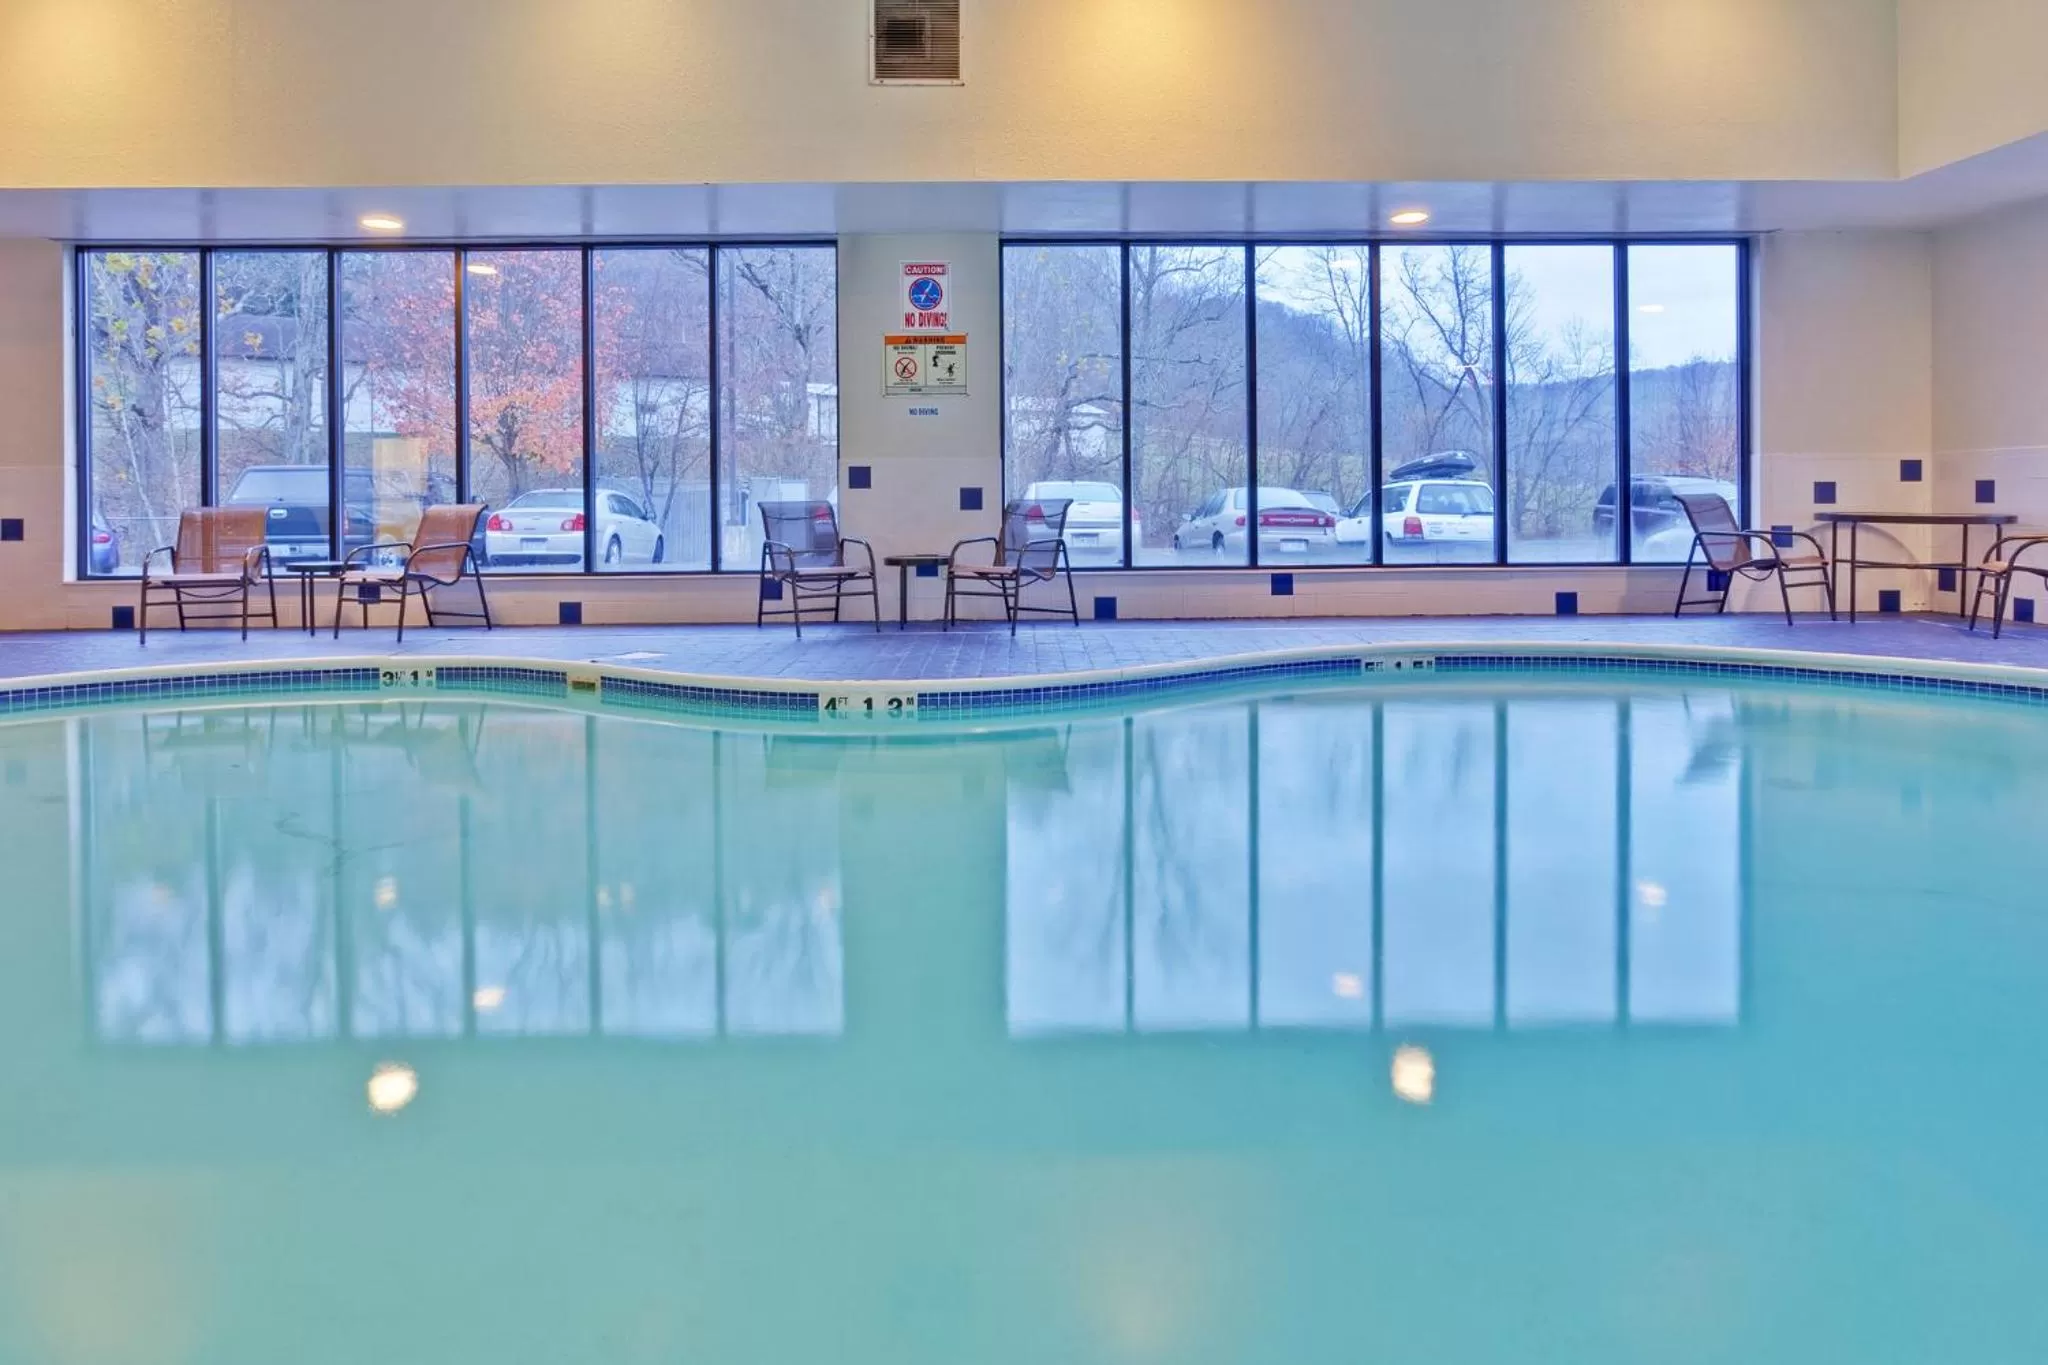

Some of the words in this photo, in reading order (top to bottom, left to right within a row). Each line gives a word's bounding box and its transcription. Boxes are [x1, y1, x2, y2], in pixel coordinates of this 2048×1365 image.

[904, 312, 915, 328] NO
[918, 312, 947, 328] DIVING!
[909, 408, 918, 416] NO
[919, 408, 939, 416] DIVING
